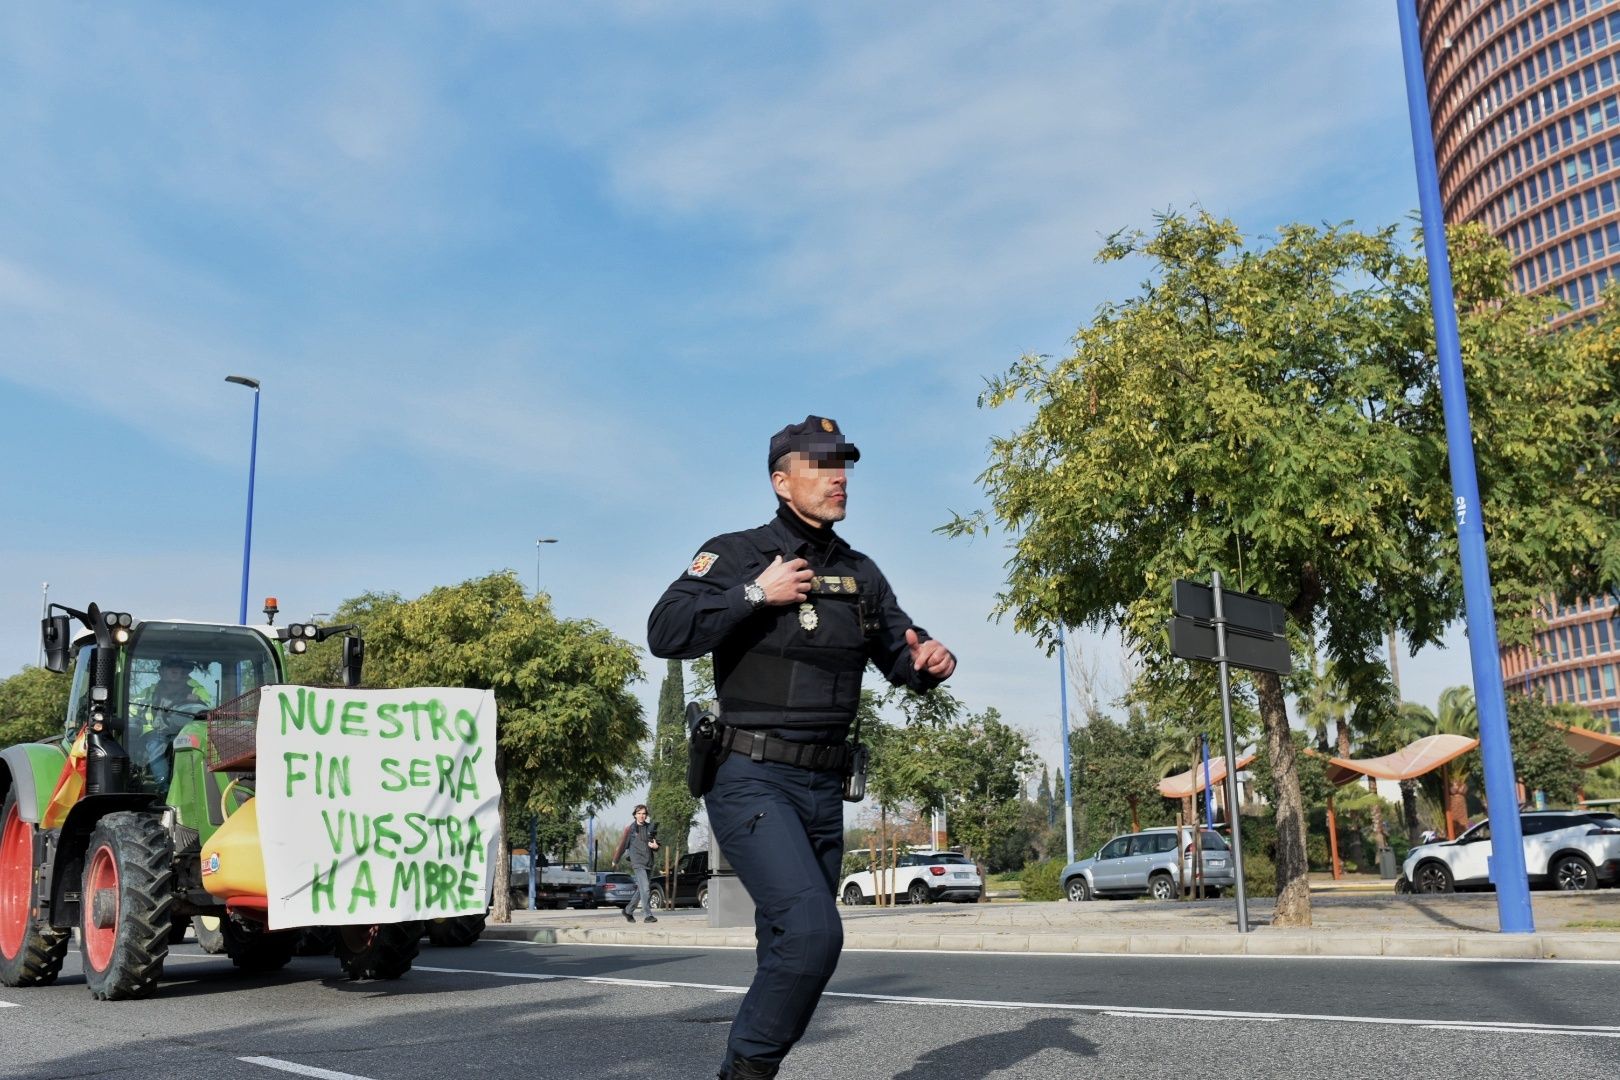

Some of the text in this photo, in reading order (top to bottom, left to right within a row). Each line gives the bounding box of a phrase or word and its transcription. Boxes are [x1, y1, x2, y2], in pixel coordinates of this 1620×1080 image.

[277, 687, 480, 745] NUESTRO
[283, 746, 483, 803] FIN SERÁ
[321, 808, 485, 869] VUESTRA
[311, 858, 484, 914] HAMBRE
